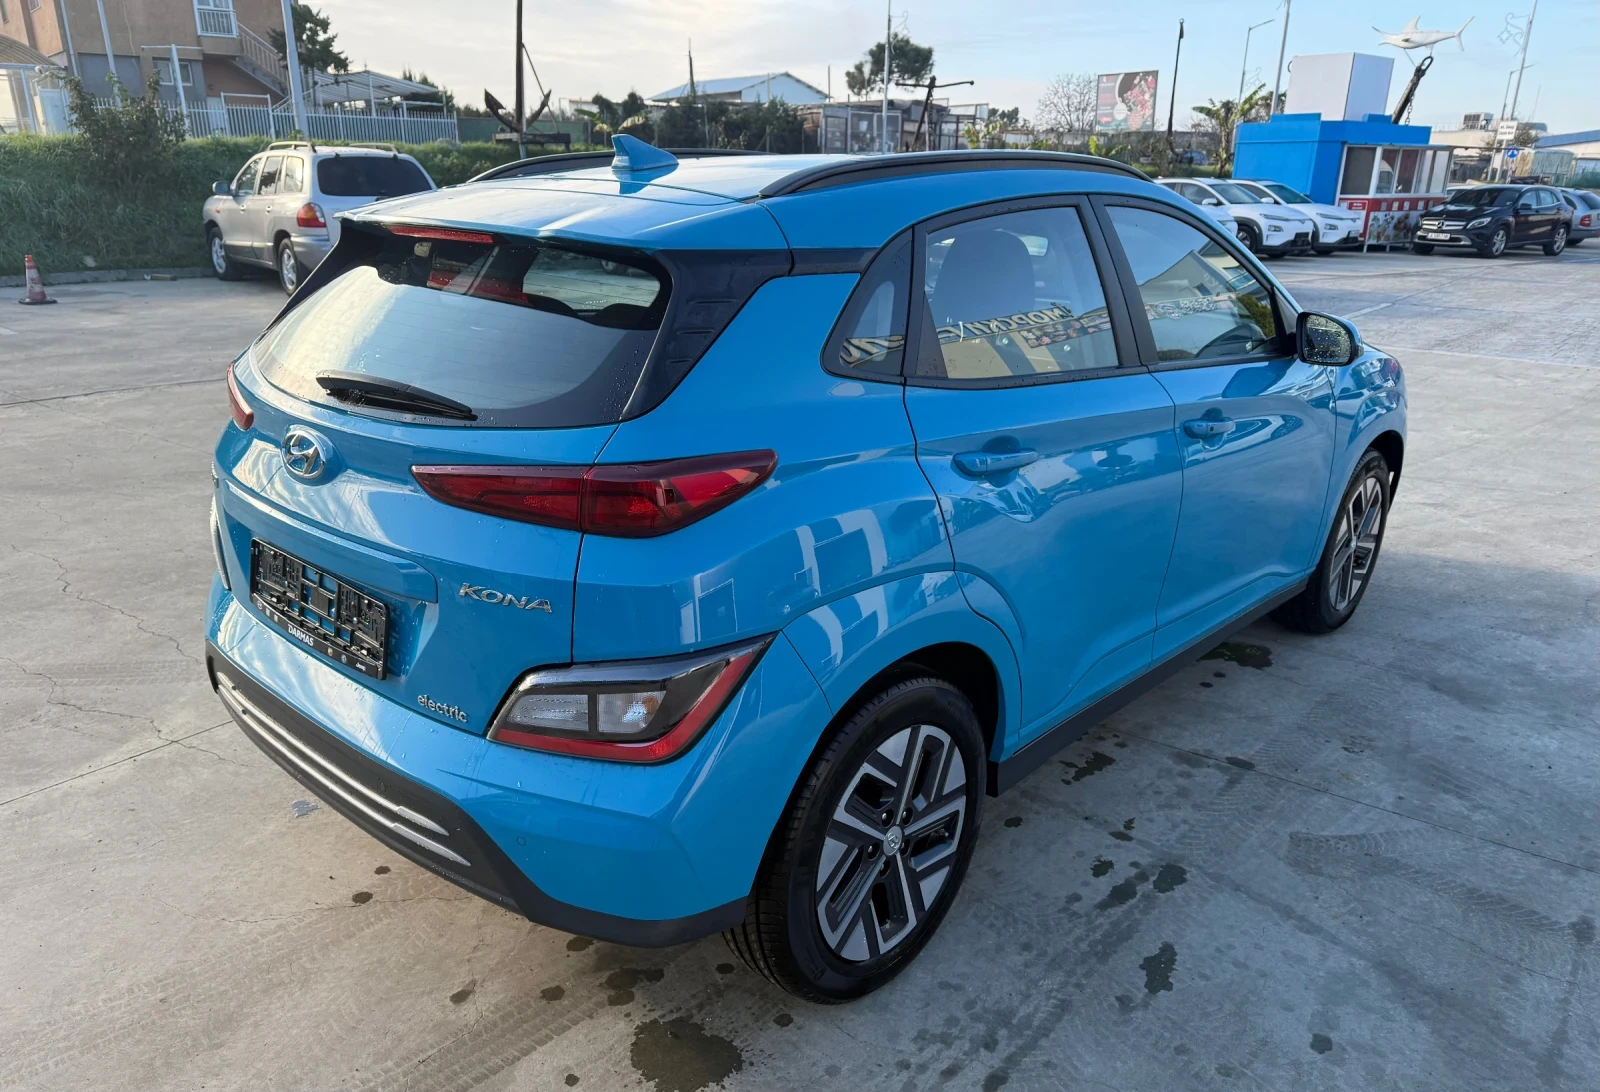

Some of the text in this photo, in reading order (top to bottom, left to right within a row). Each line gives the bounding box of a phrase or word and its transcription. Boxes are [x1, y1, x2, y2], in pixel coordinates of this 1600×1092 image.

[459, 582, 553, 613] KONA
[287, 623, 314, 647] DARMAS
[417, 693, 469, 723] electric
